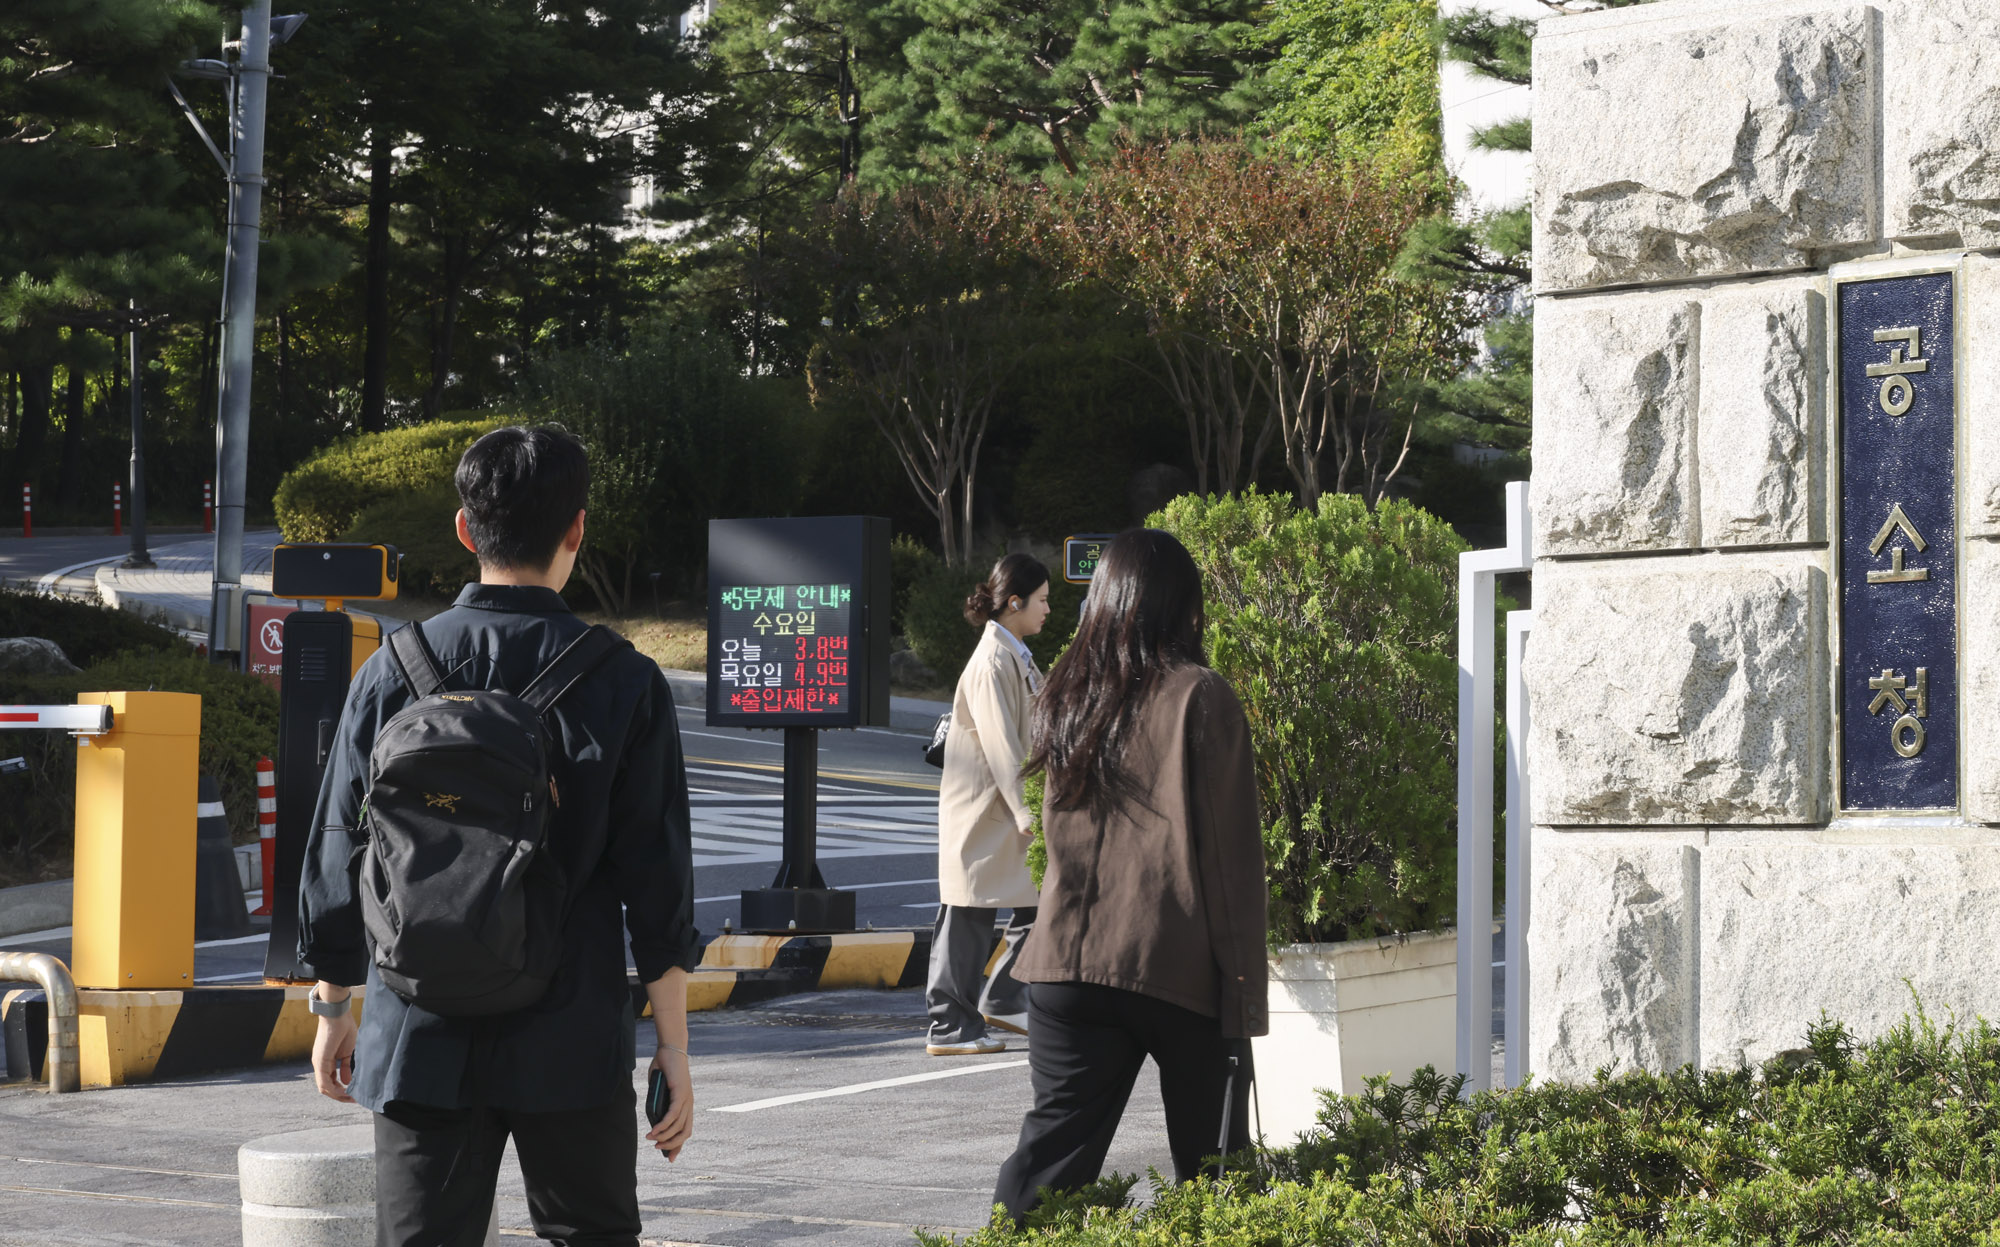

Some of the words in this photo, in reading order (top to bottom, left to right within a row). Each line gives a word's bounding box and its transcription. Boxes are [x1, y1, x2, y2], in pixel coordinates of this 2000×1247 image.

[1866, 326, 1929, 758] 공소청
[753, 611, 815, 635] 수요일
[721, 638, 762, 662] 오늘
[795, 636, 848, 660] 3,8번
[720, 662, 782, 687] 목요일
[794, 662, 847, 686] 4,9번
